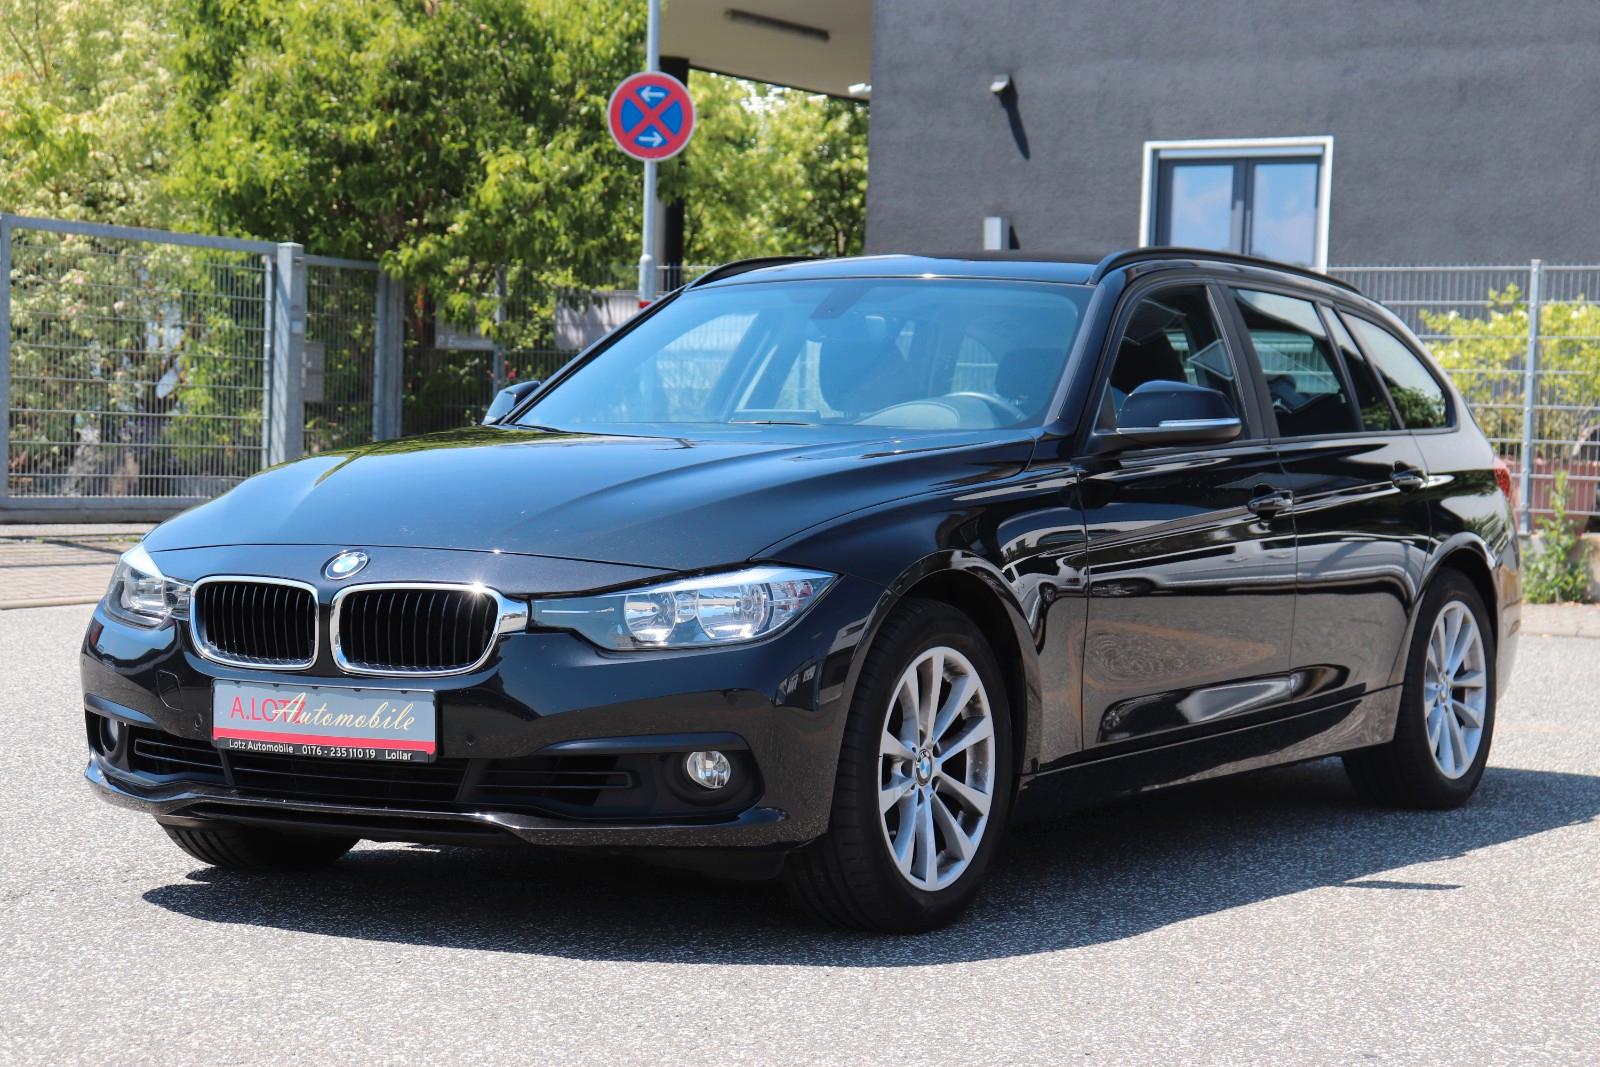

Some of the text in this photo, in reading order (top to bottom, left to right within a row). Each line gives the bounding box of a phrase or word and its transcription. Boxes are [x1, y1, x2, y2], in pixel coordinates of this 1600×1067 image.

[271, 692, 415, 730] Automobile
[229, 739, 246, 749] Lotz
[247, 740, 294, 753] Automobile
[302, 745, 322, 755] 0176
[330, 747, 347, 757] 235
[349, 748, 363, 758] 110
[365, 749, 376, 758] 19
[385, 749, 412, 760] Lollar
